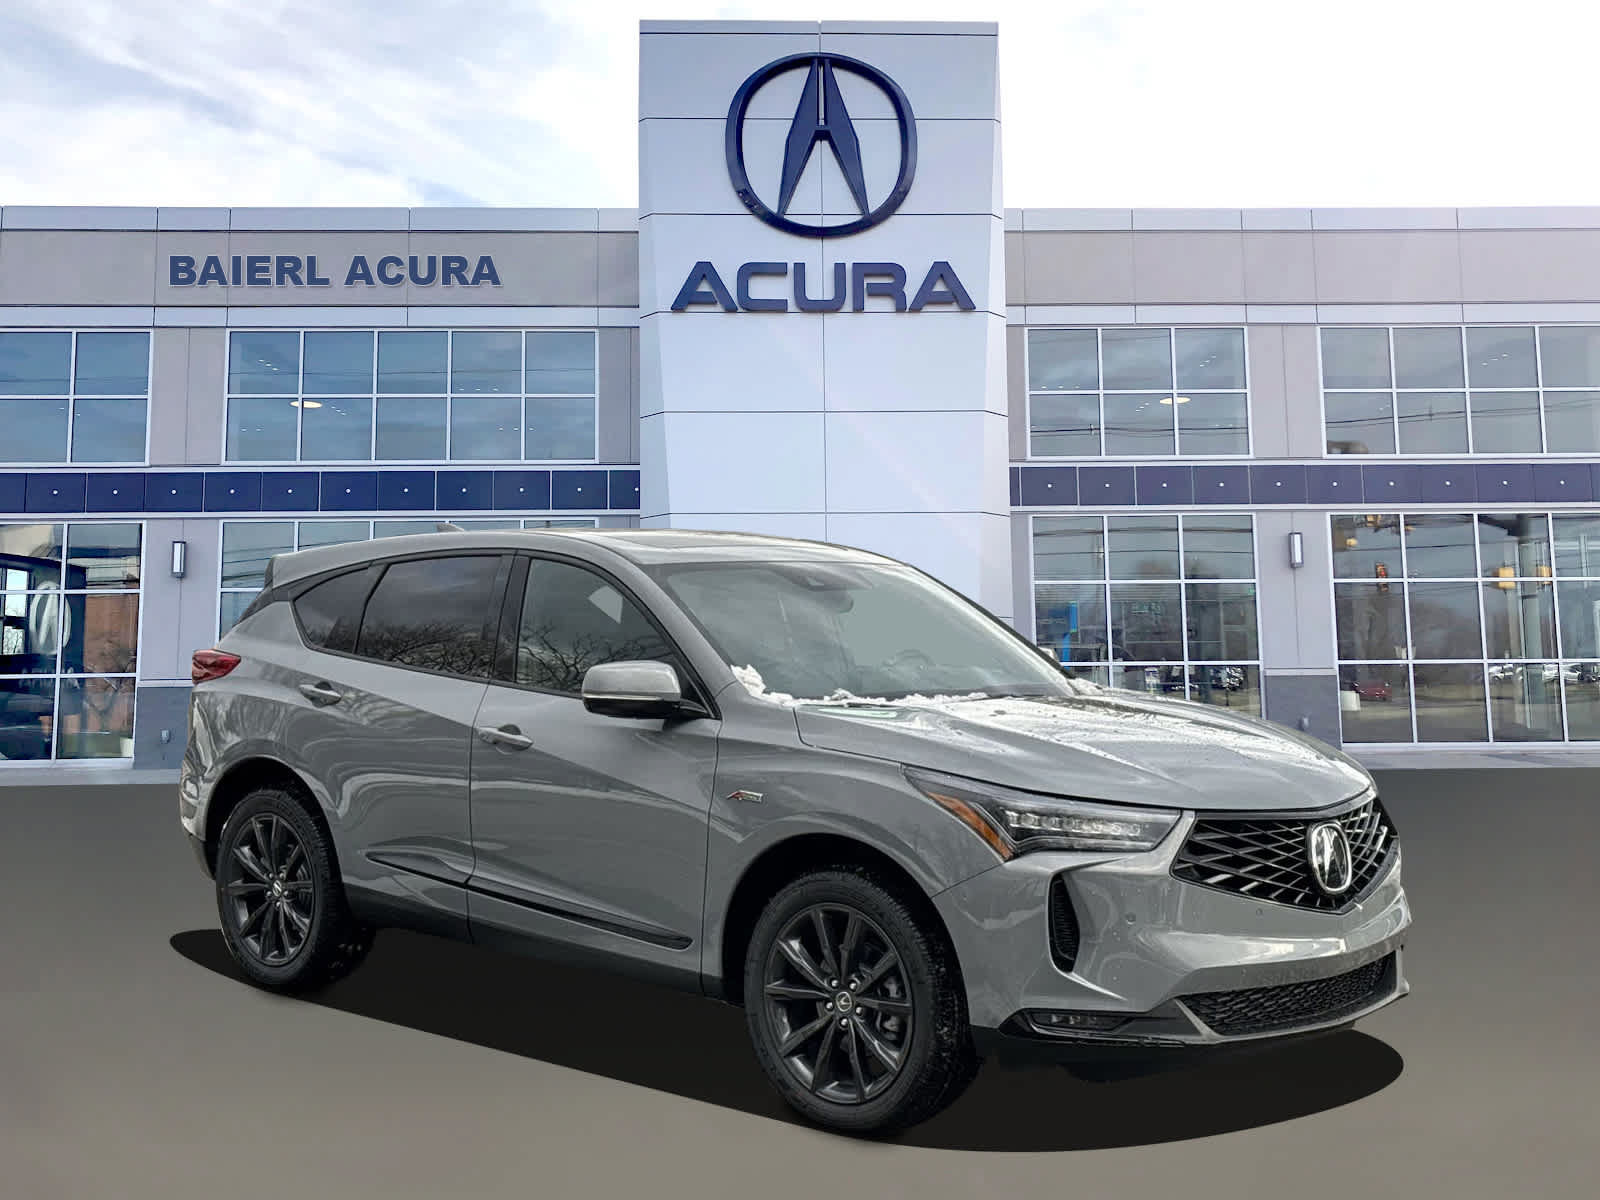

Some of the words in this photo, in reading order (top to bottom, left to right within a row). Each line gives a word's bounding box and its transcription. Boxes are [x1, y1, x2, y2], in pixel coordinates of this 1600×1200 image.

[168, 255, 331, 286] BAIERL
[344, 255, 502, 286] ACURA
[671, 261, 976, 312] ACURA
